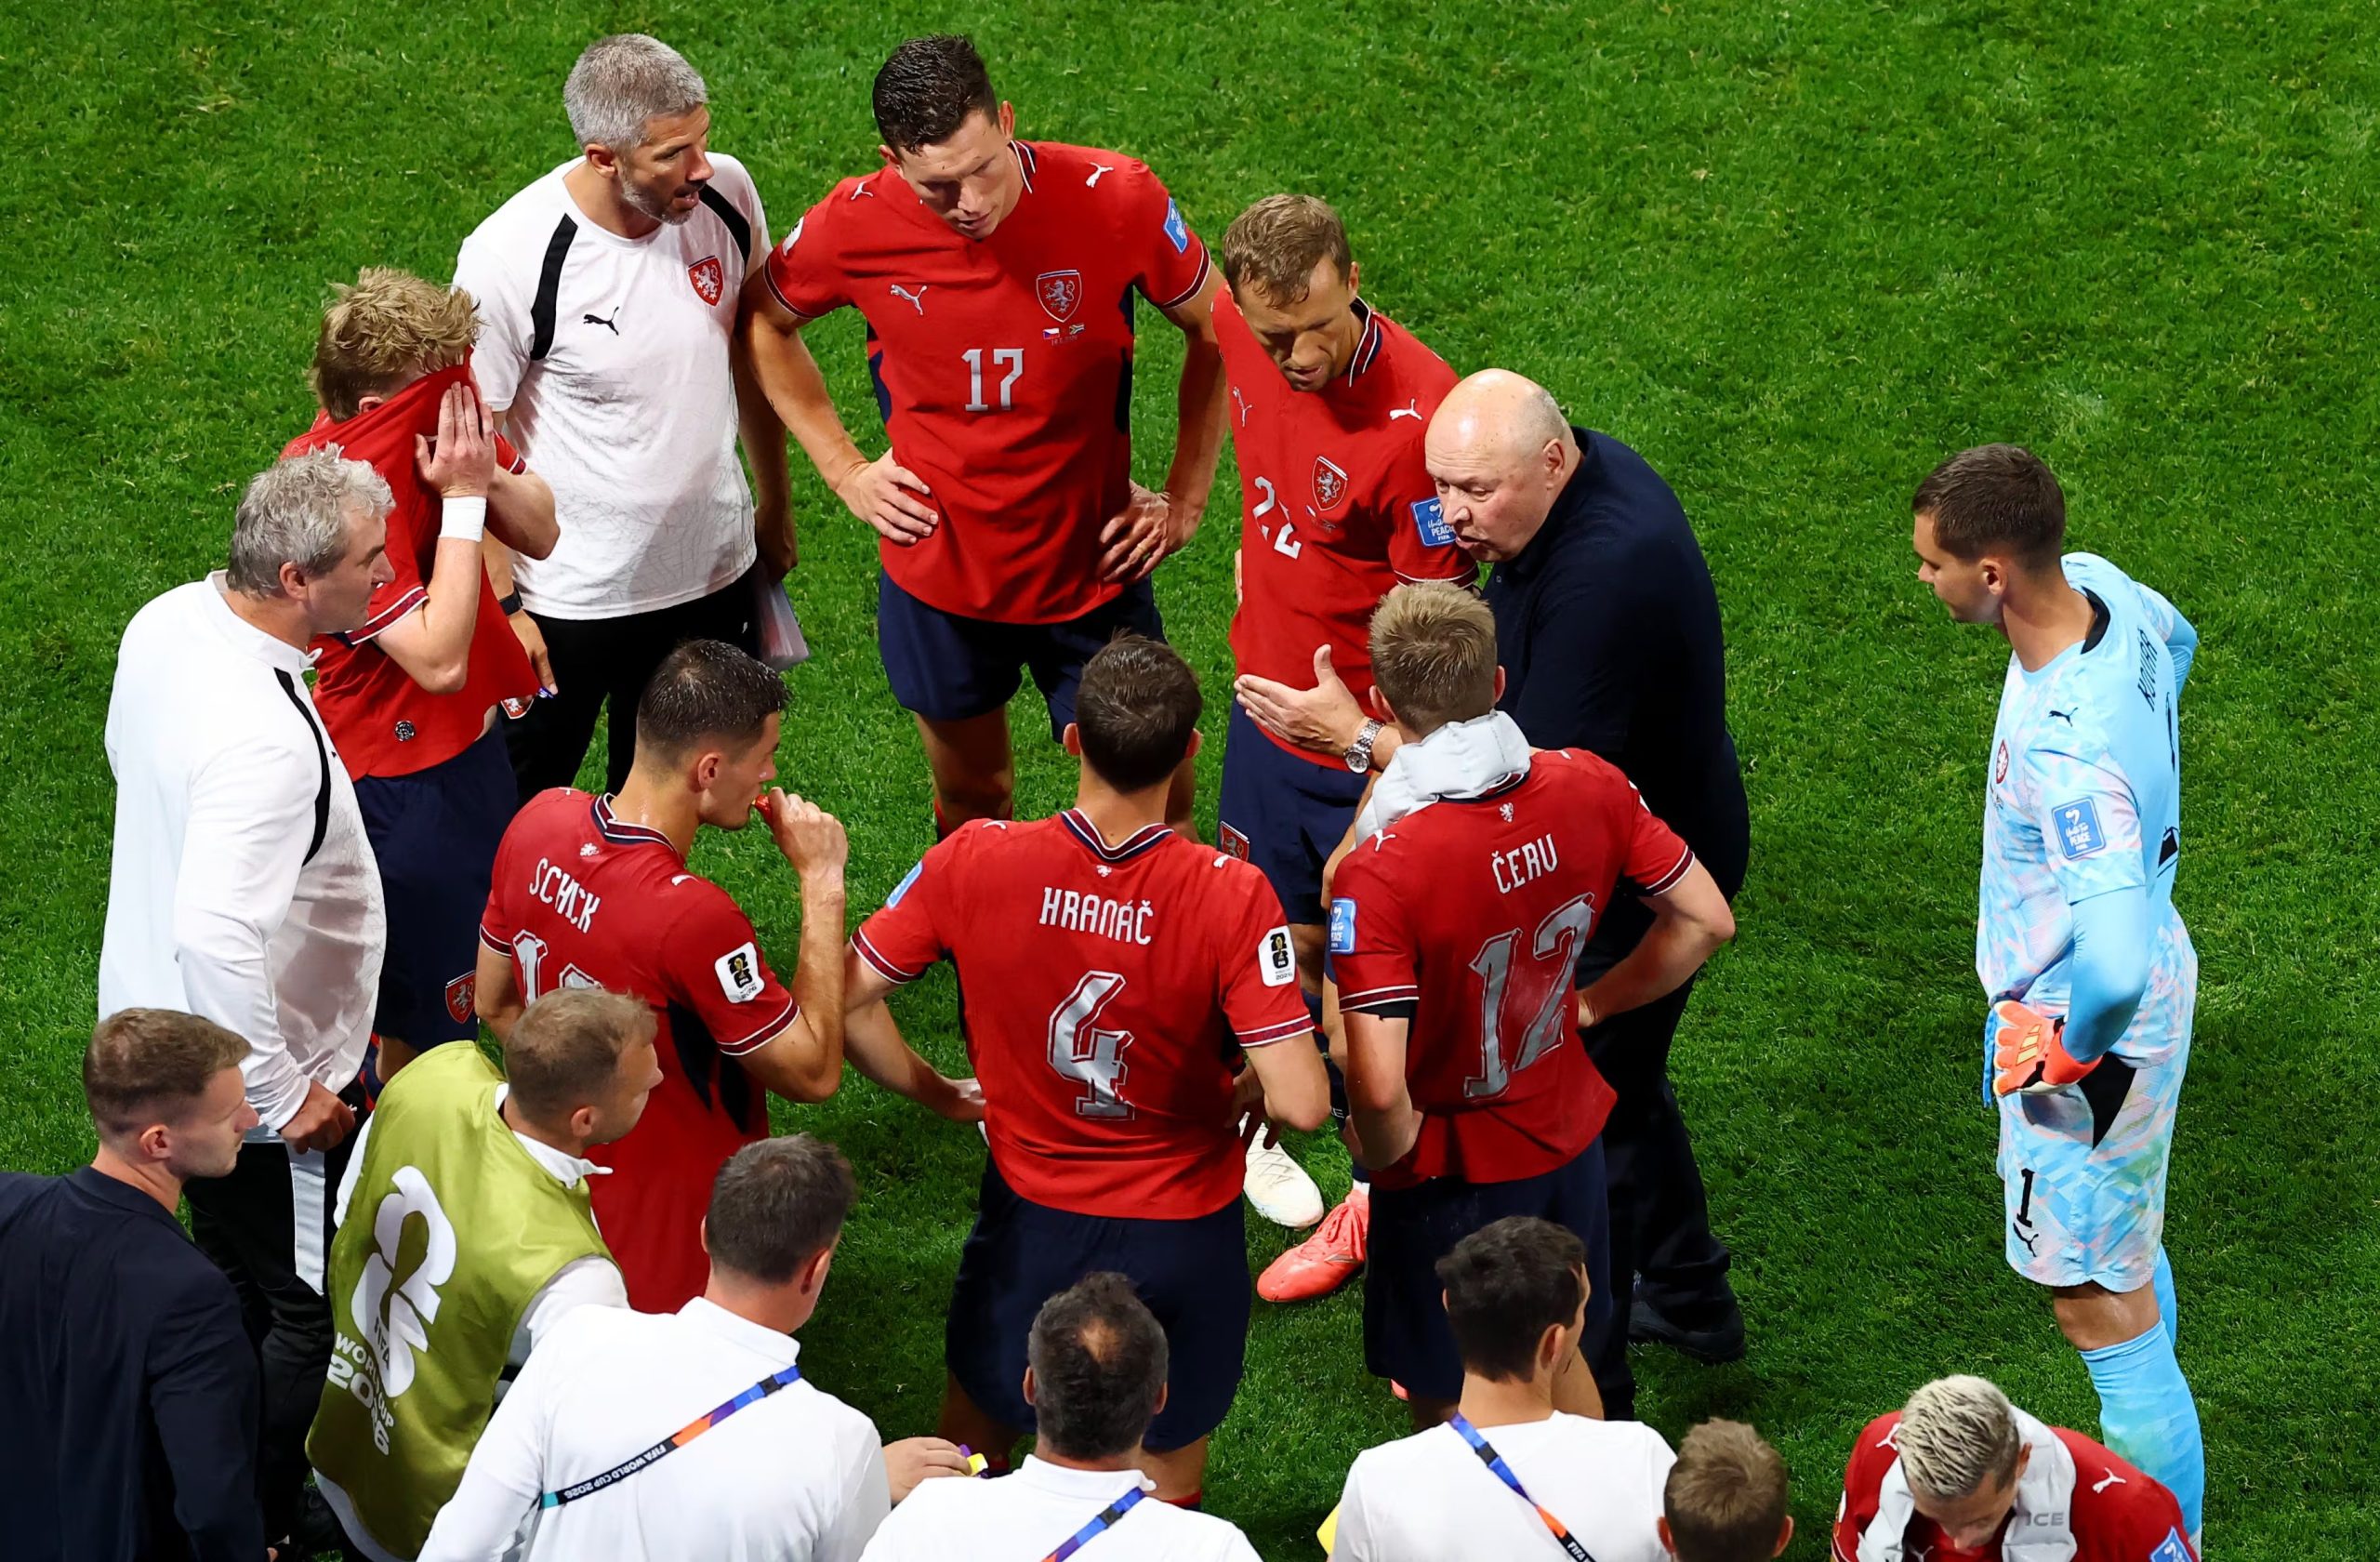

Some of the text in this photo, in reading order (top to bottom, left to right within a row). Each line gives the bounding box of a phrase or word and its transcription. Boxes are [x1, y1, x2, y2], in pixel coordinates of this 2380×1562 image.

[960, 348, 1025, 411] 17
[1038, 886, 1154, 945] HRANÁČ
[1463, 892, 1595, 1099] 12
[1047, 970, 1136, 1121] 4
[2016, 1168, 2036, 1228] 1
[326, 1354, 390, 1456] 2026
[563, 1444, 667, 1499] FIFA WORLD CUP 2026
[1567, 1541, 1586, 1561] FIFA
